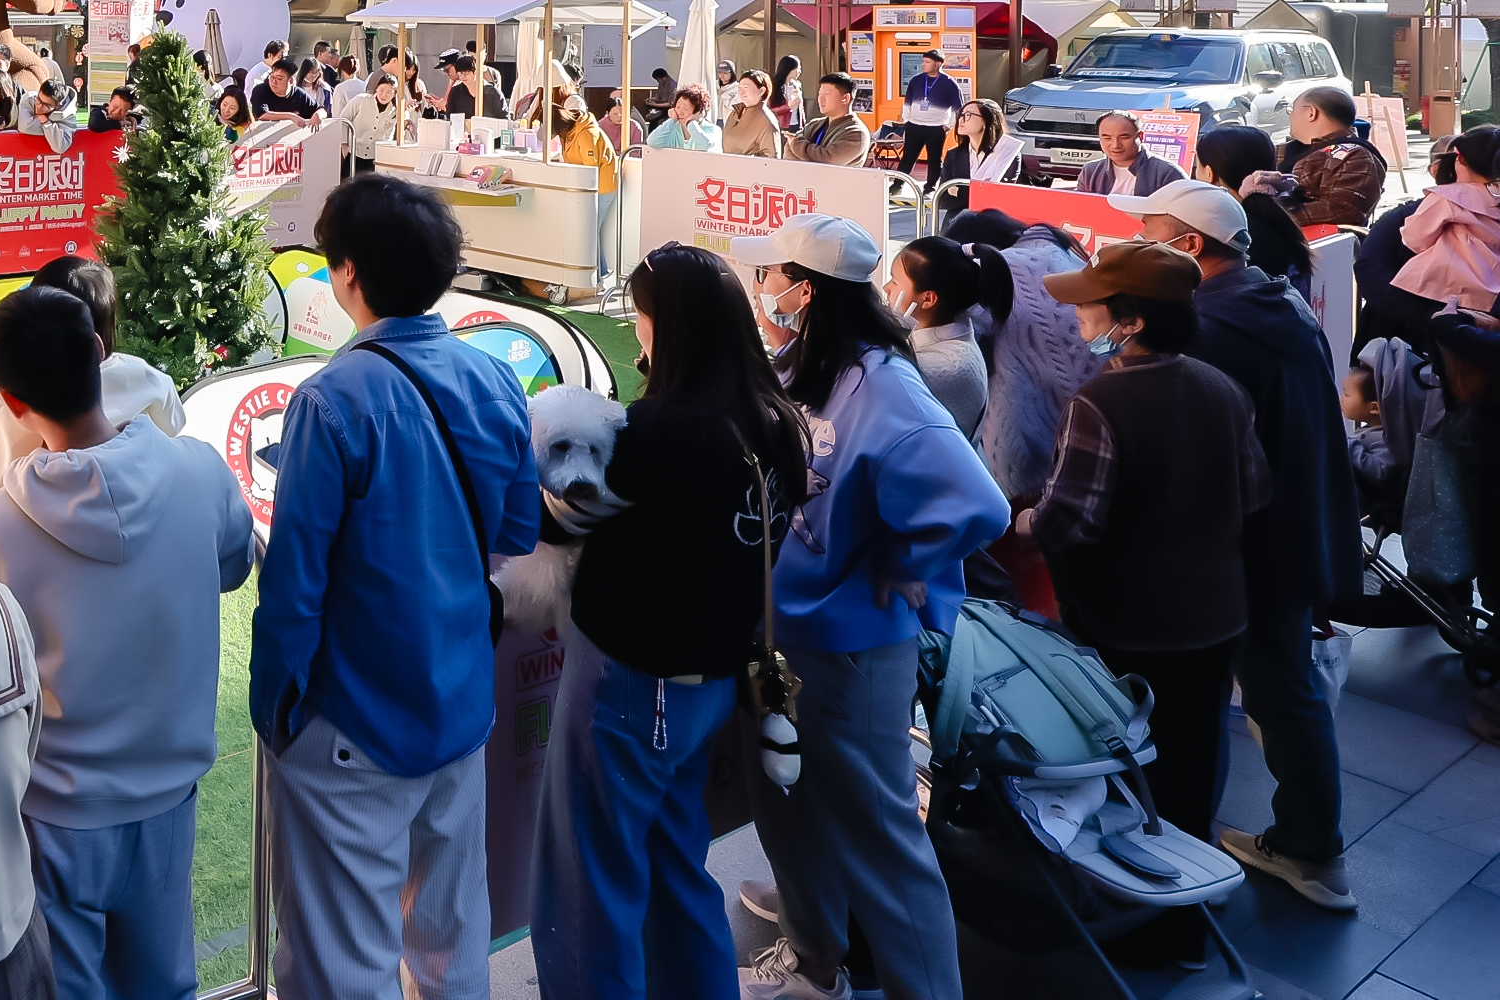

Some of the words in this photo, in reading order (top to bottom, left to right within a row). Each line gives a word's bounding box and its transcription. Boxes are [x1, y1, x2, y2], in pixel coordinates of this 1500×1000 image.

[231, 140, 304, 179] 冬日派对
[1060, 150, 1093, 159] M817
[229, 179, 254, 189] WINTER
[255, 177, 284, 186] MARKET
[286, 175, 302, 184] TIME
[24, 192, 61, 203] MARKET
[62, 191, 83, 200] TIME
[40, 203, 86, 221] PARTY
[697, 219, 736, 234] WINTER
[740, 225, 775, 237] MARK
[230, 390, 271, 456] WESTIE
[235, 469, 262, 509] ELEGANT
